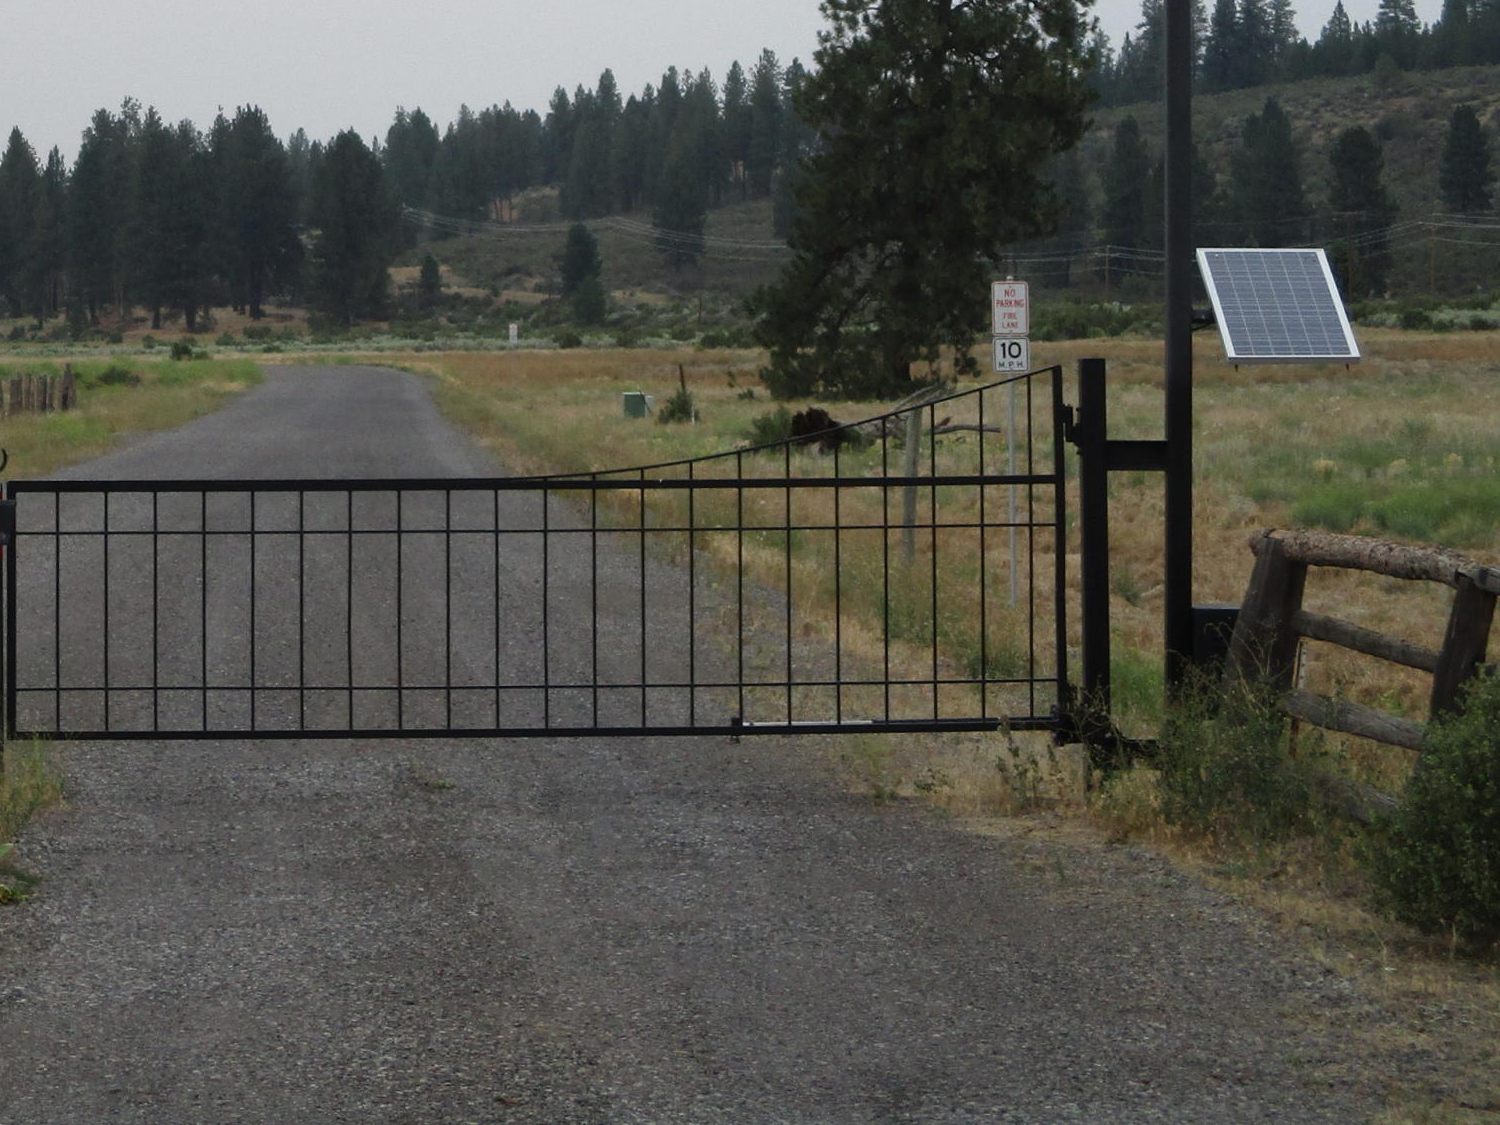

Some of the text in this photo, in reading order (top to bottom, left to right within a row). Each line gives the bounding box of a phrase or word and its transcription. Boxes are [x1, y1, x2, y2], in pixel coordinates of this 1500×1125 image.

[1004, 289, 1016, 297] NO
[996, 299, 1025, 308] PARKING
[1000, 342, 1022, 359] 10
